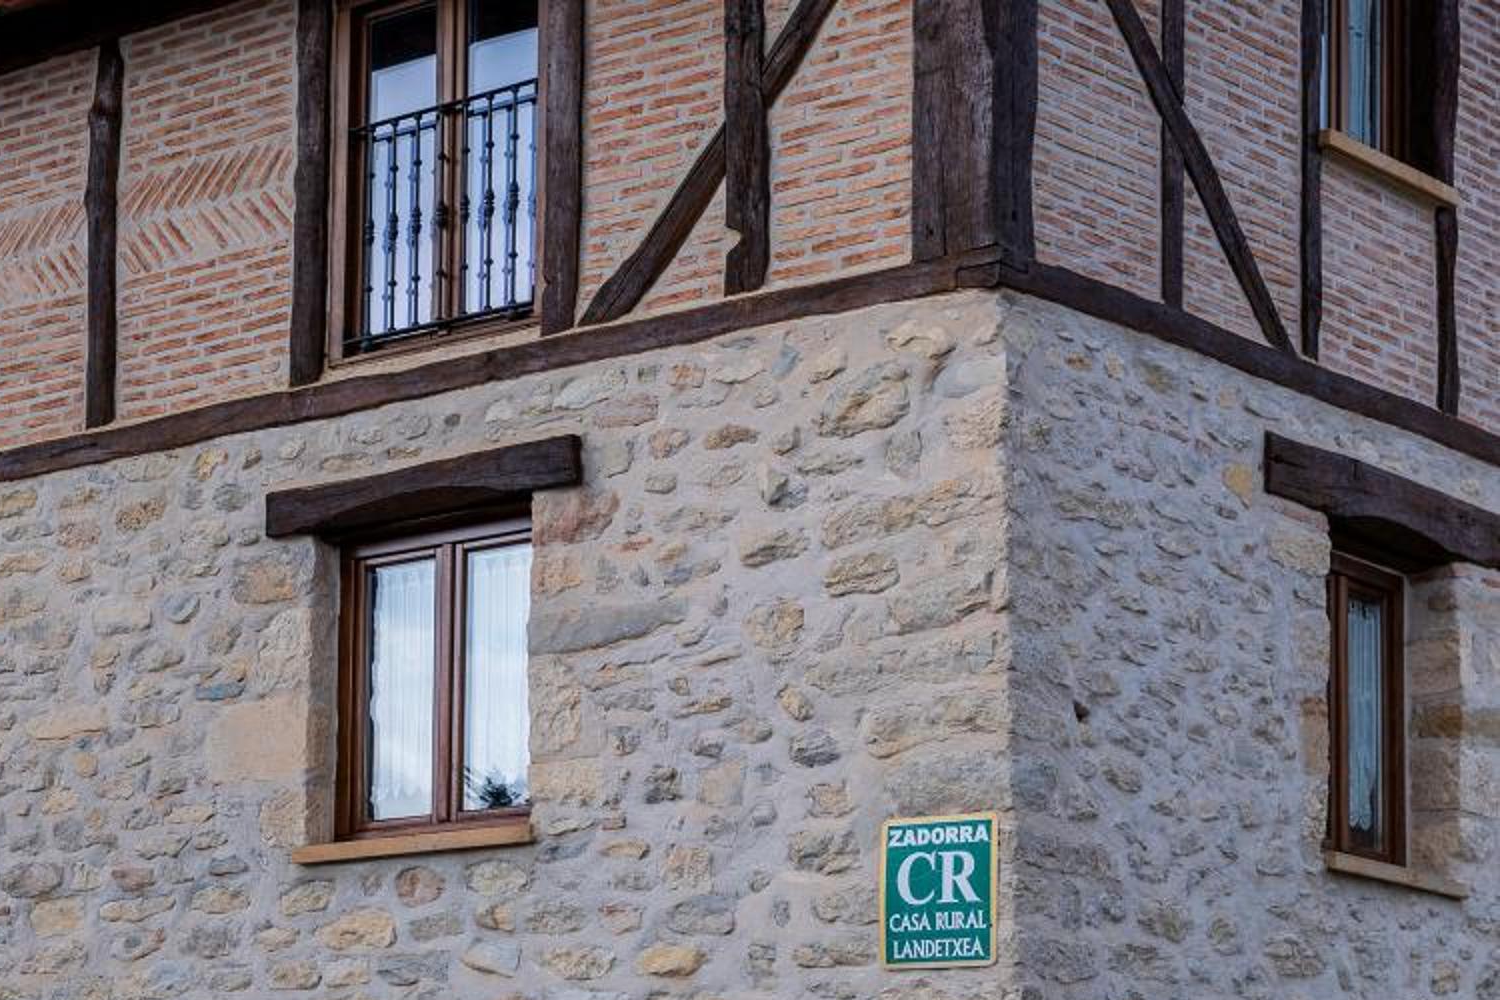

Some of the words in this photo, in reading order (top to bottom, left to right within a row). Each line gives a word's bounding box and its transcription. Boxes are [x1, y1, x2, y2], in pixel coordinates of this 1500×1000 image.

[889, 825, 989, 847] ZADORRA
[897, 850, 982, 905] CR
[889, 914, 931, 933] CASA
[935, 910, 987, 931] RURAL
[893, 938, 985, 959] LANDETXEA
